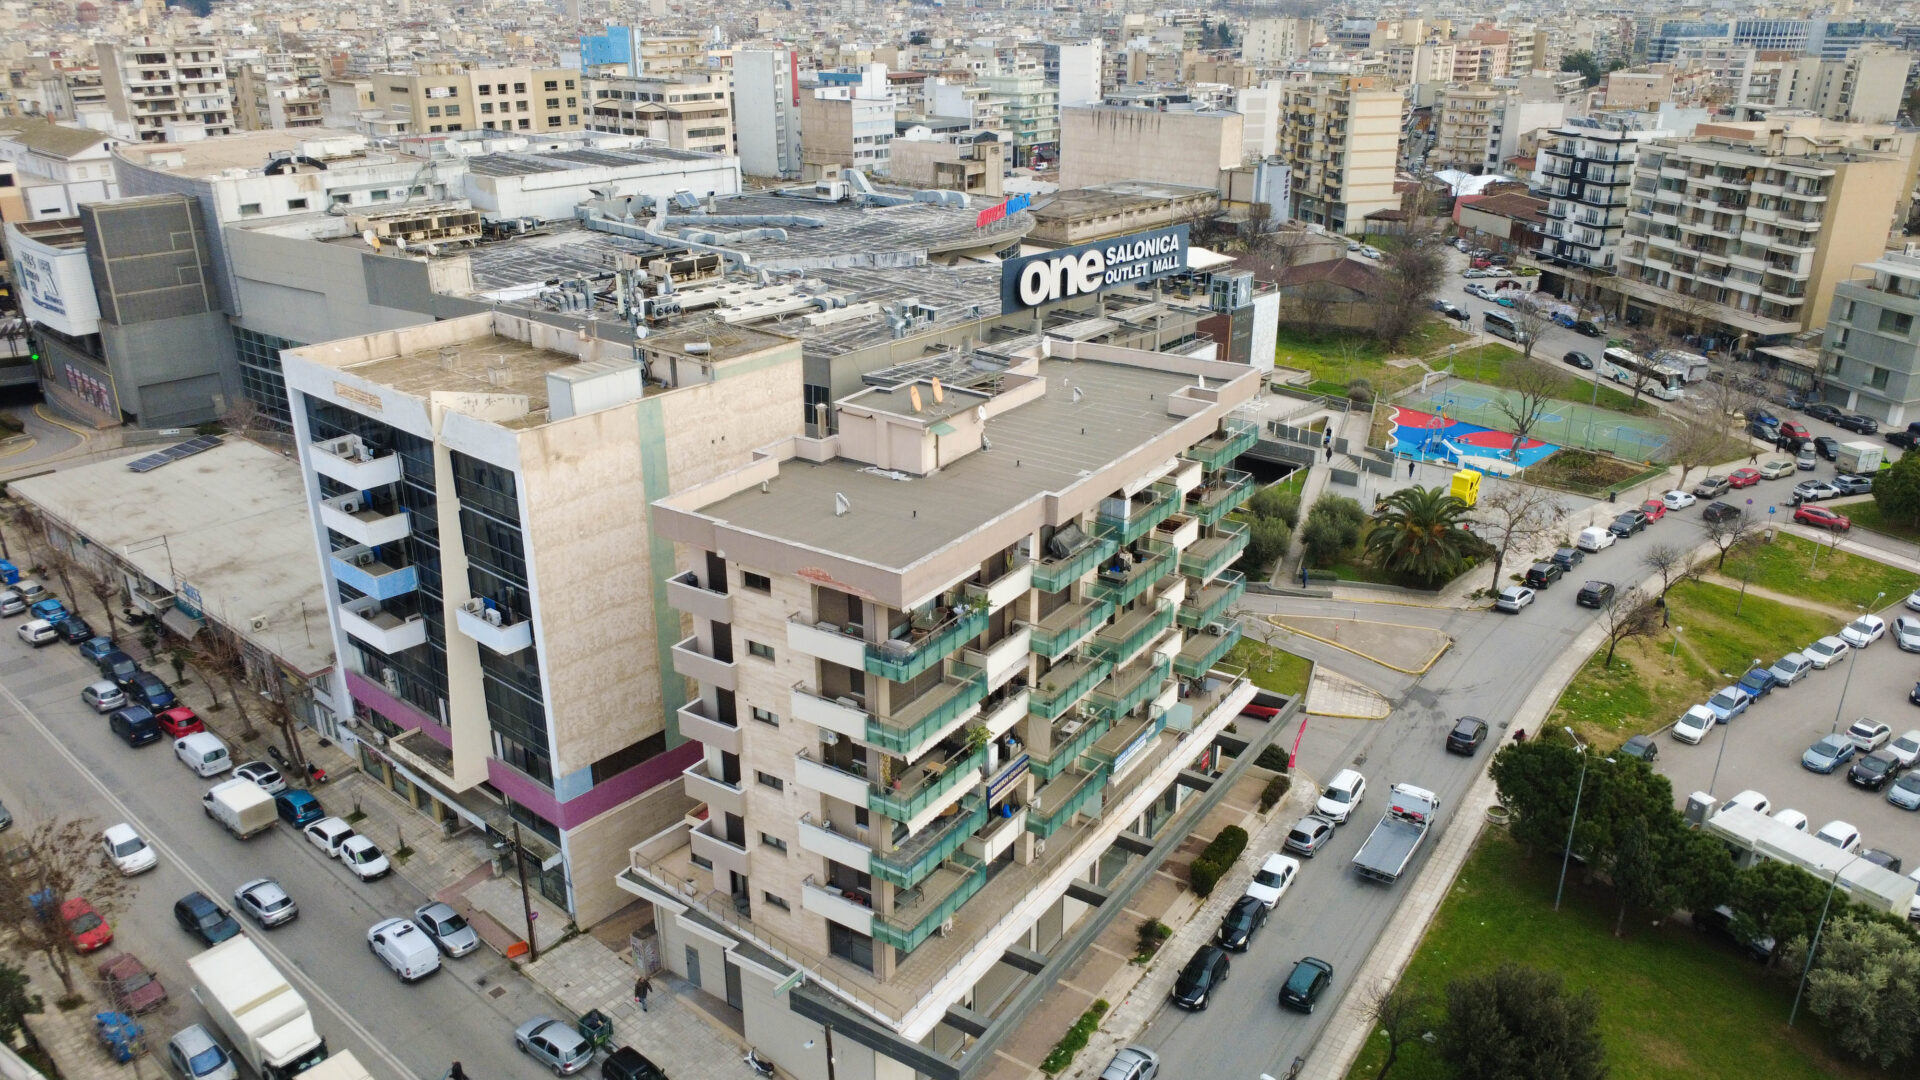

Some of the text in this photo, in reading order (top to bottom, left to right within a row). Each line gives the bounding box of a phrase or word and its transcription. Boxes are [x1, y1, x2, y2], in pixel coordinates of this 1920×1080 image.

[1106, 234, 1179, 266] SALONICA
[1020, 249, 1105, 306] one
[1105, 256, 1179, 284] OUTLET MALL
